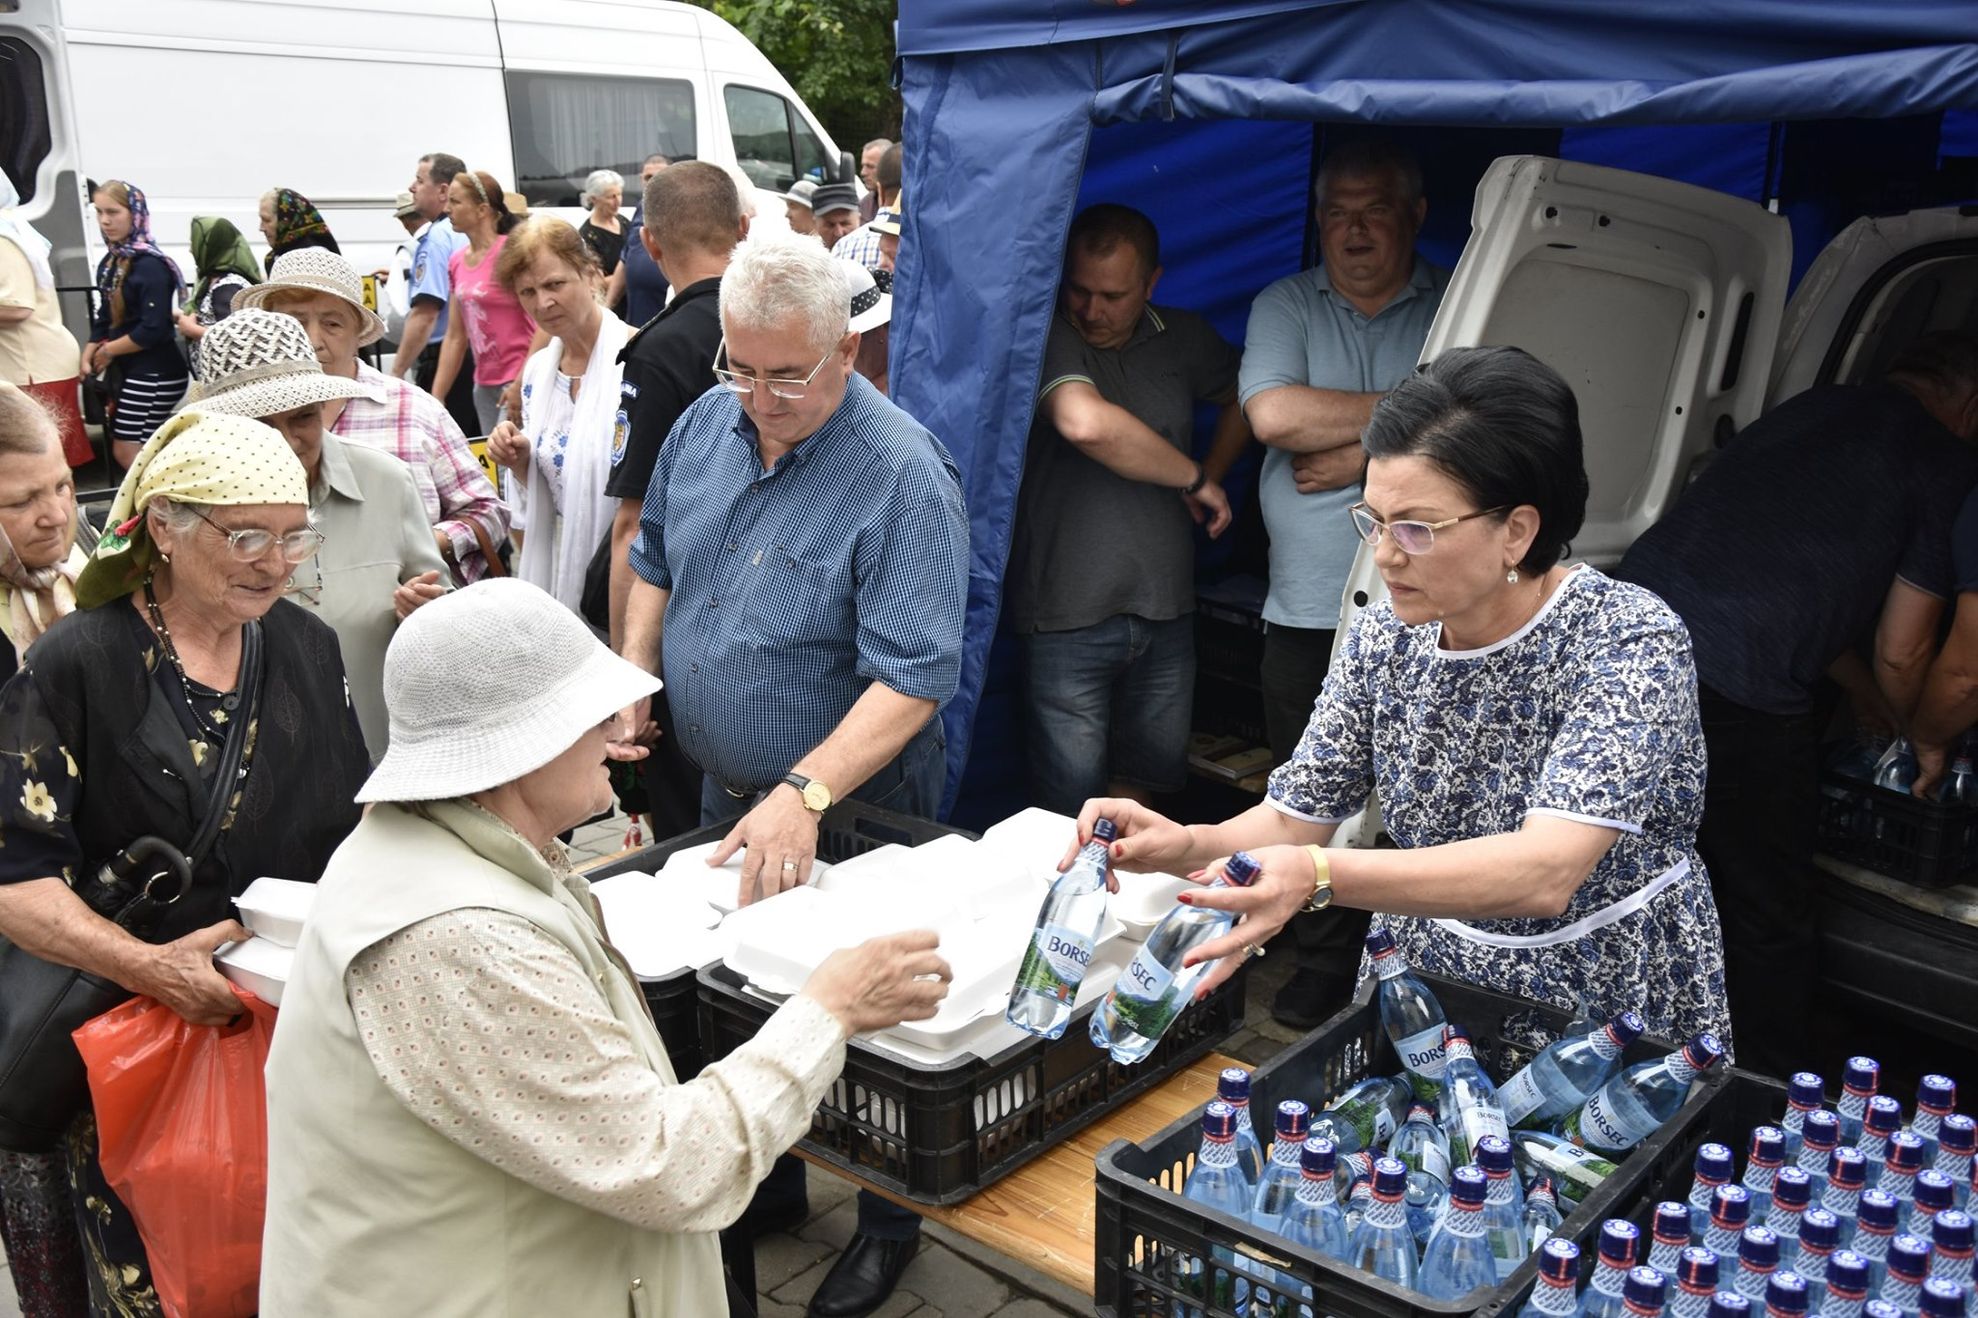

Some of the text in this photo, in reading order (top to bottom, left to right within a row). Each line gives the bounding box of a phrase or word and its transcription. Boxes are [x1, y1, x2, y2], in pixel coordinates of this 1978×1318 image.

[1048, 936, 1089, 968] BORSE
[1408, 1044, 1446, 1068] BORS
[1588, 1095, 1630, 1146] BORSEC
